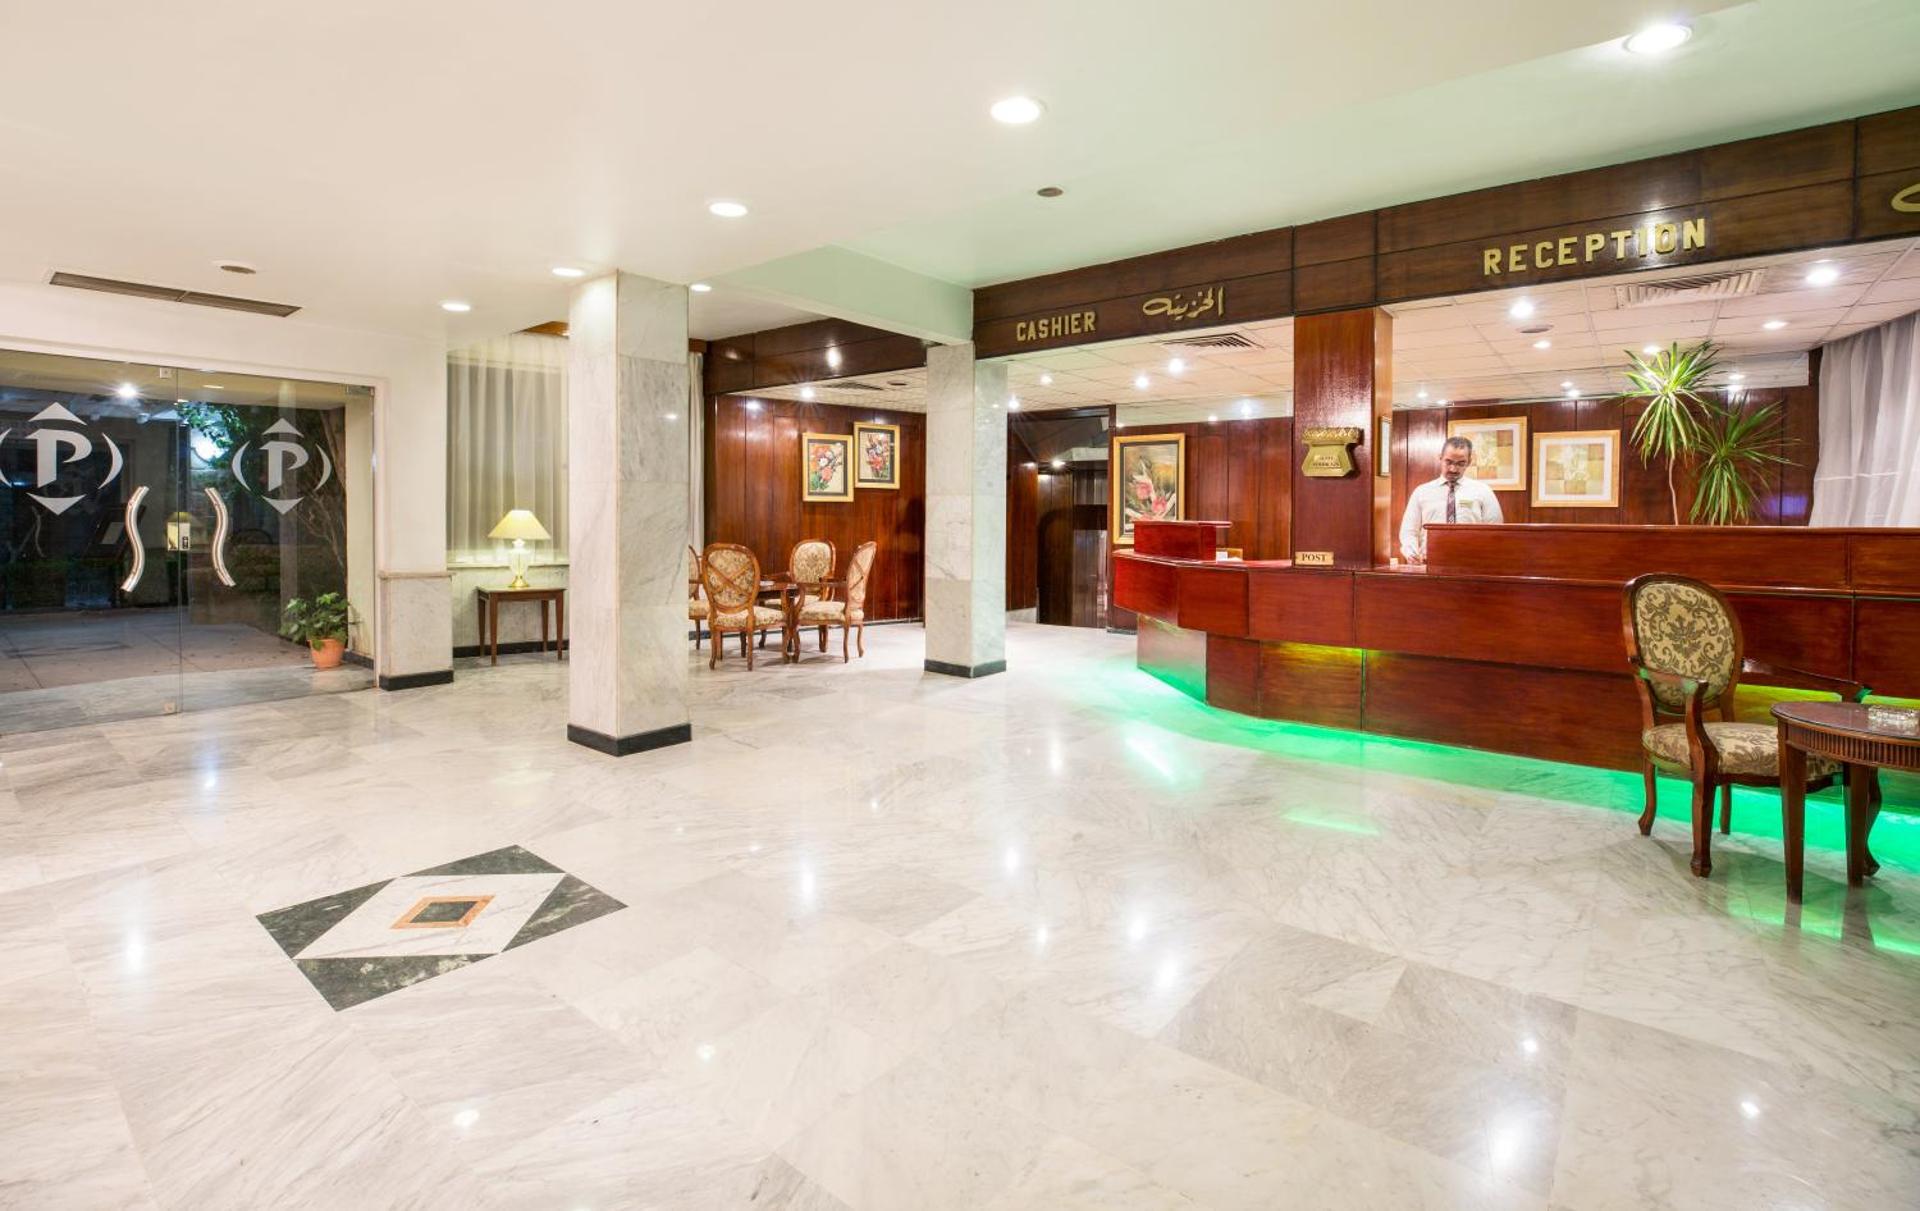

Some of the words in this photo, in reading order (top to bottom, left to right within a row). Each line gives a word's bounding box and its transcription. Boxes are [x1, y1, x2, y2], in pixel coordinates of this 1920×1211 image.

[1483, 218, 1706, 276] RECEPTION
[1016, 311, 1096, 341] CASHIER
[1301, 553, 1327, 562] POST
